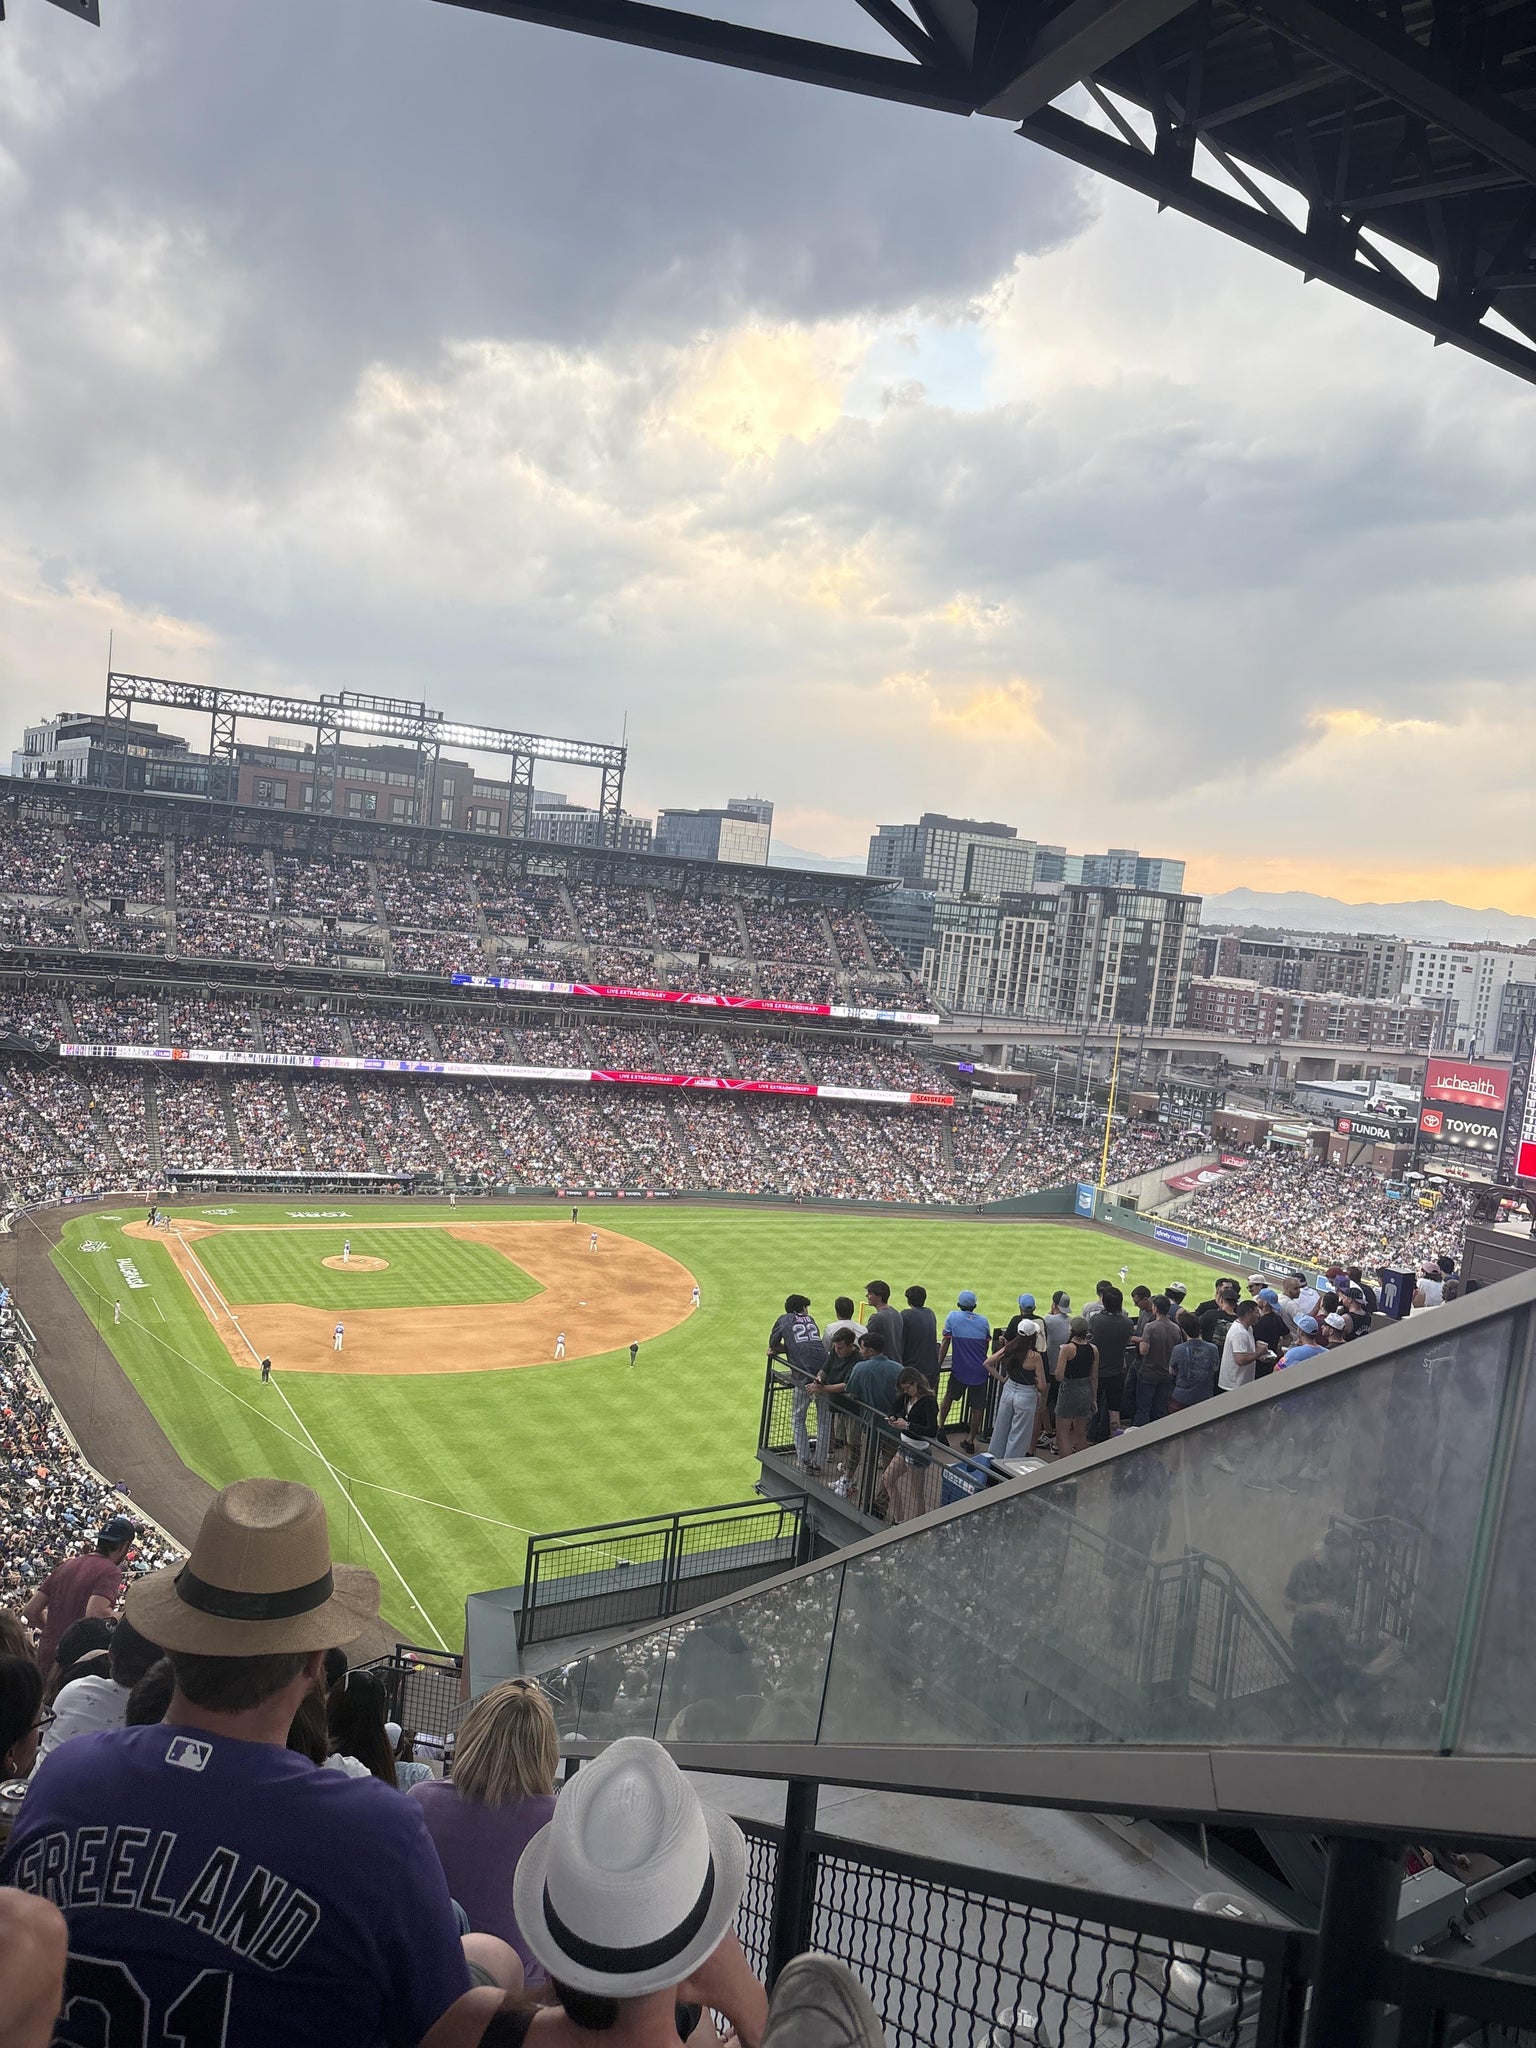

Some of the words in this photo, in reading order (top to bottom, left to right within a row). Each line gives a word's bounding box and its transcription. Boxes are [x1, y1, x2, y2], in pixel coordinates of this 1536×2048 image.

[619, 989, 667, 999] EXTRAORDINARY
[690, 995, 717, 1004] uchealth
[774, 1003, 819, 1012] EXTRAORDINARY
[630, 1075, 674, 1083] EXTRAORDINARY
[1437, 1074, 1495, 1096] uchealth
[769, 1084, 810, 1092] EXTRAORDINARY
[916, 1094, 947, 1104] SEATGEEK
[1351, 1122, 1391, 1139] TUNDRA
[1446, 1119, 1498, 1139] TOYOTA
[1156, 1229, 1171, 1239] xfinity
[1171, 1234, 1187, 1243] mobile
[792, 1323, 820, 1343] 22
[14, 1825, 321, 1972] FREELAND
